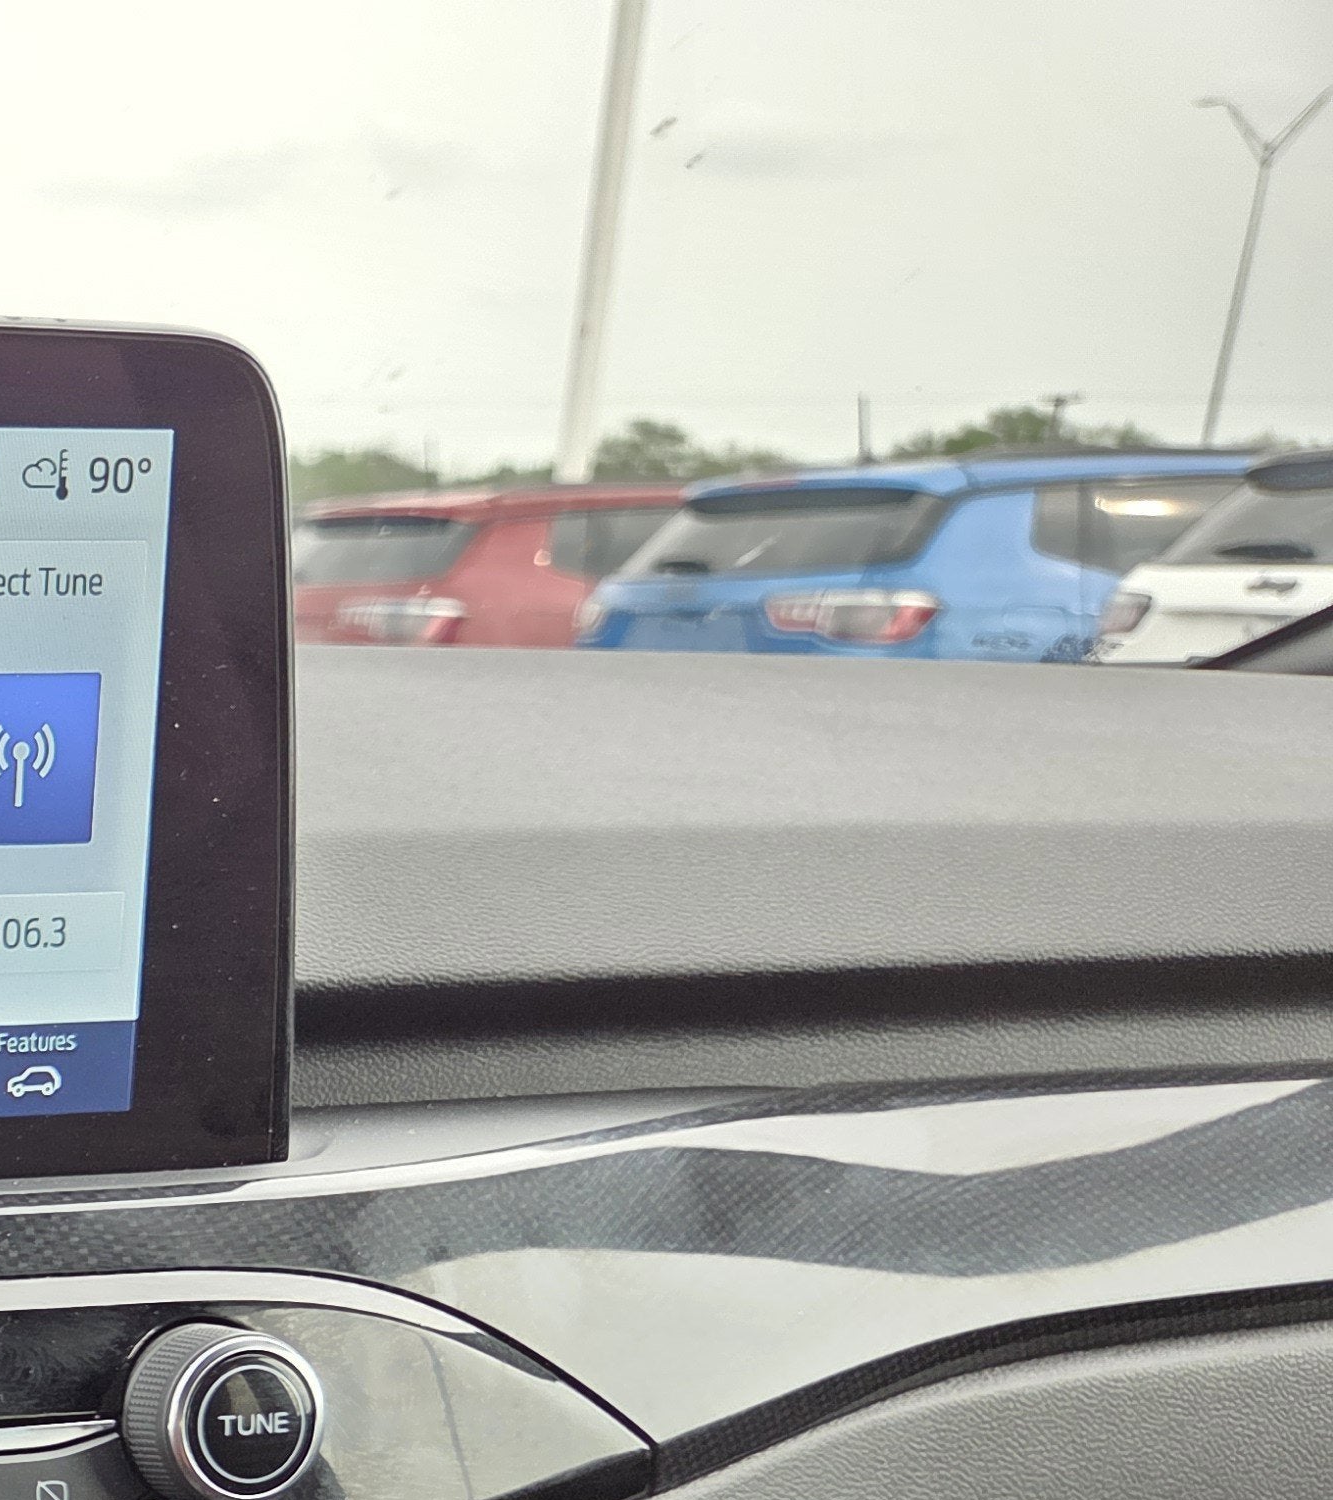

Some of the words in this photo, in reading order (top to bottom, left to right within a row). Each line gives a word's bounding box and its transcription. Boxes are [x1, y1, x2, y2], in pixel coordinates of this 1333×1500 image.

[89, 457, 152, 494] 90°
[39, 567, 104, 597] Tune
[217, 1411, 290, 1437] TUNE
